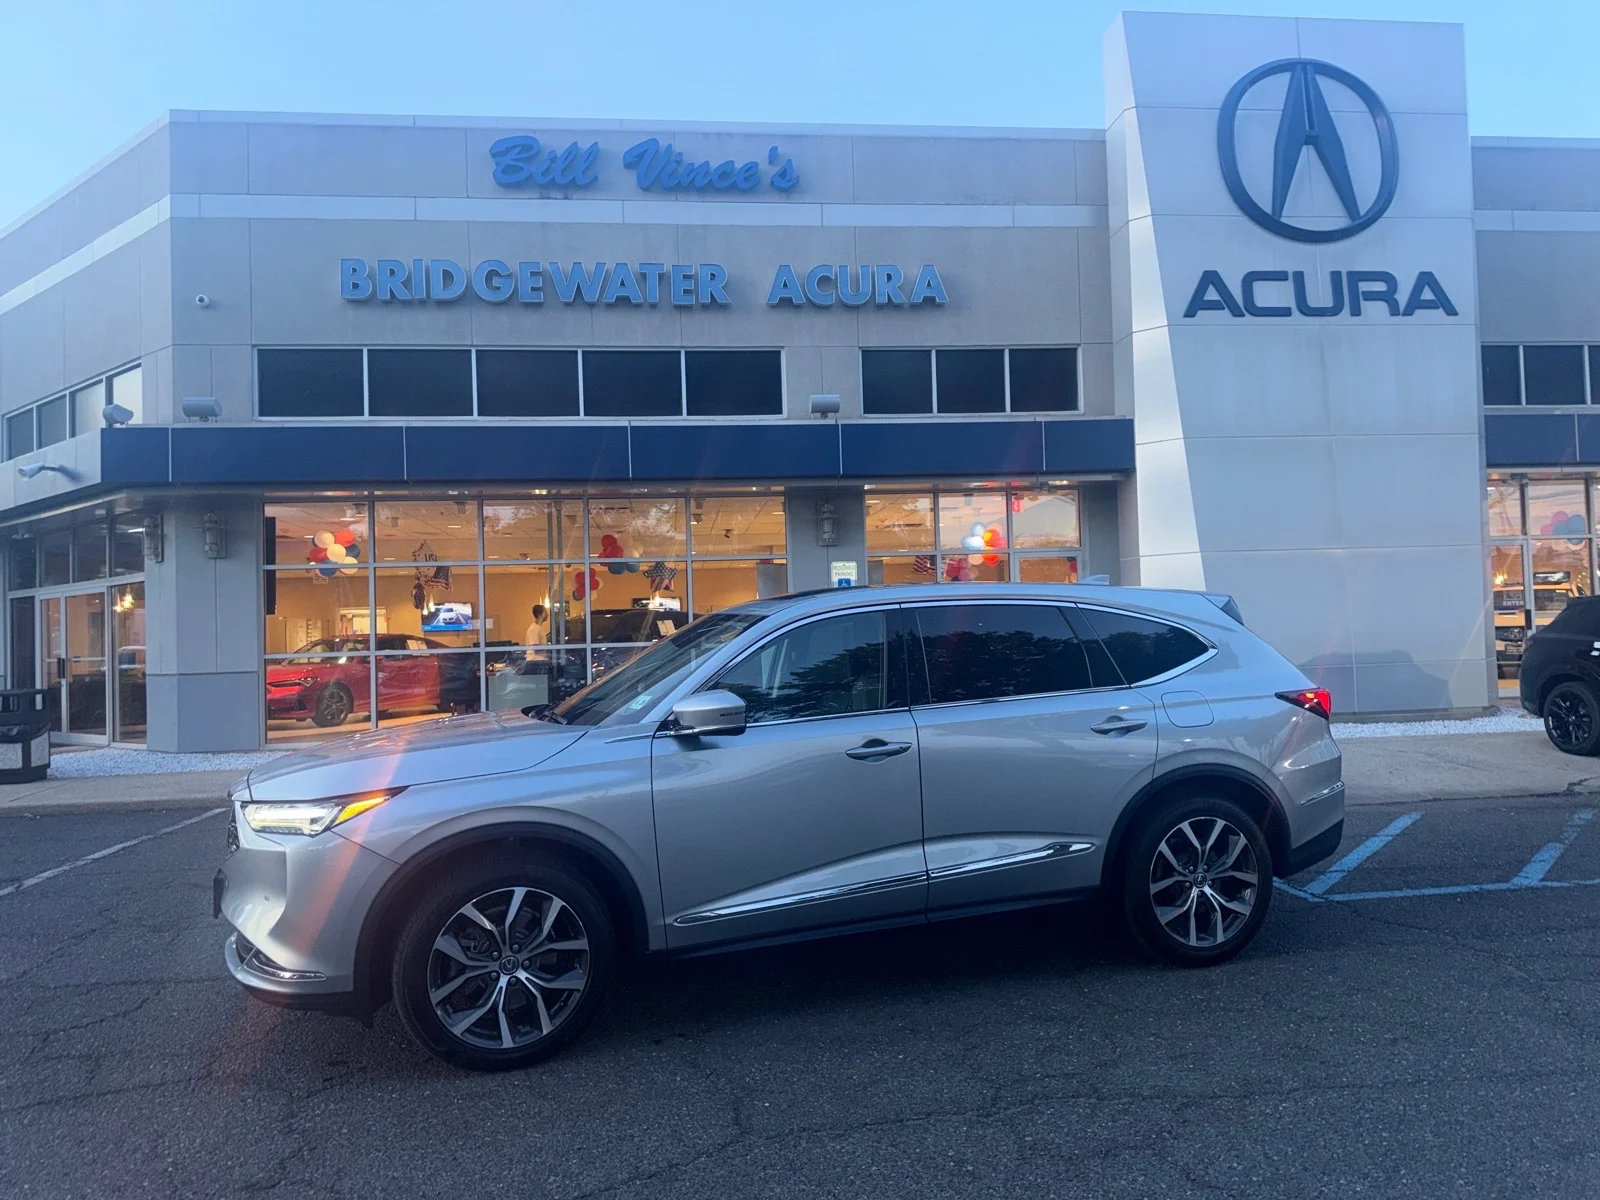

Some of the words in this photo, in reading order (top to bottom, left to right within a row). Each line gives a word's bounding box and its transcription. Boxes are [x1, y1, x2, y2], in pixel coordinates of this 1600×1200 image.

[489, 135, 599, 188] Bill
[623, 137, 799, 192] Vince's
[340, 258, 731, 306] BRIDGEWATER
[766, 264, 950, 307] ACURA
[1183, 269, 1460, 318] ACURA
